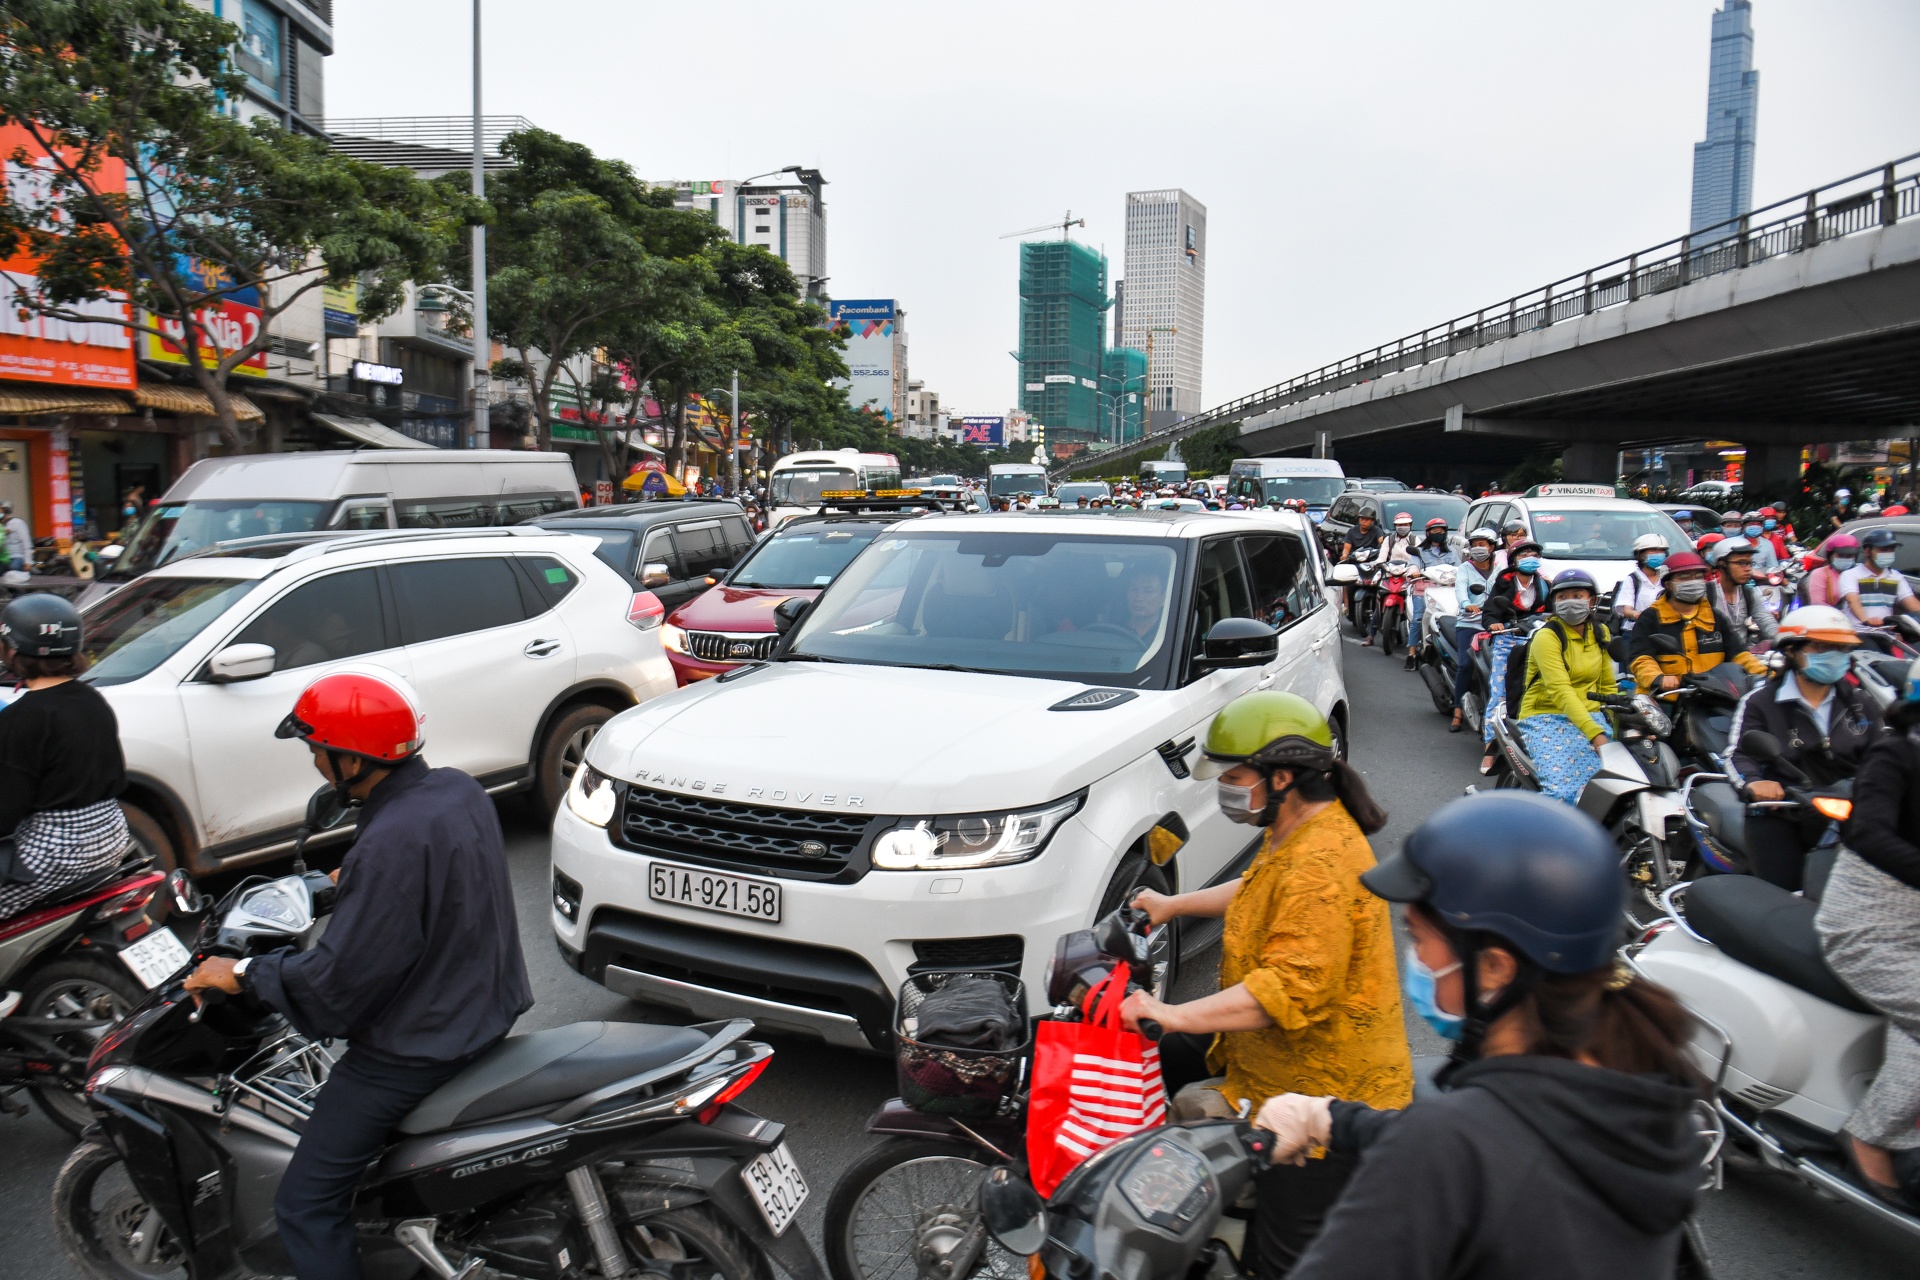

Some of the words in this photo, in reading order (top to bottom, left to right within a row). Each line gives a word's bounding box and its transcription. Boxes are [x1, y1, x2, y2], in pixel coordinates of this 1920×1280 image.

[746, 198, 768, 206] HSBC
[787, 198, 808, 208] 194
[838, 304, 890, 314] Sacombank
[733, 644, 751, 654] KIA
[635, 768, 728, 794] RANGE
[747, 786, 866, 808] ROVER
[653, 867, 776, 917] 51A-921.58
[451, 1161, 489, 1180] AIR
[491, 1138, 569, 1168] BLADE
[764, 1168, 806, 1229] 592.29
